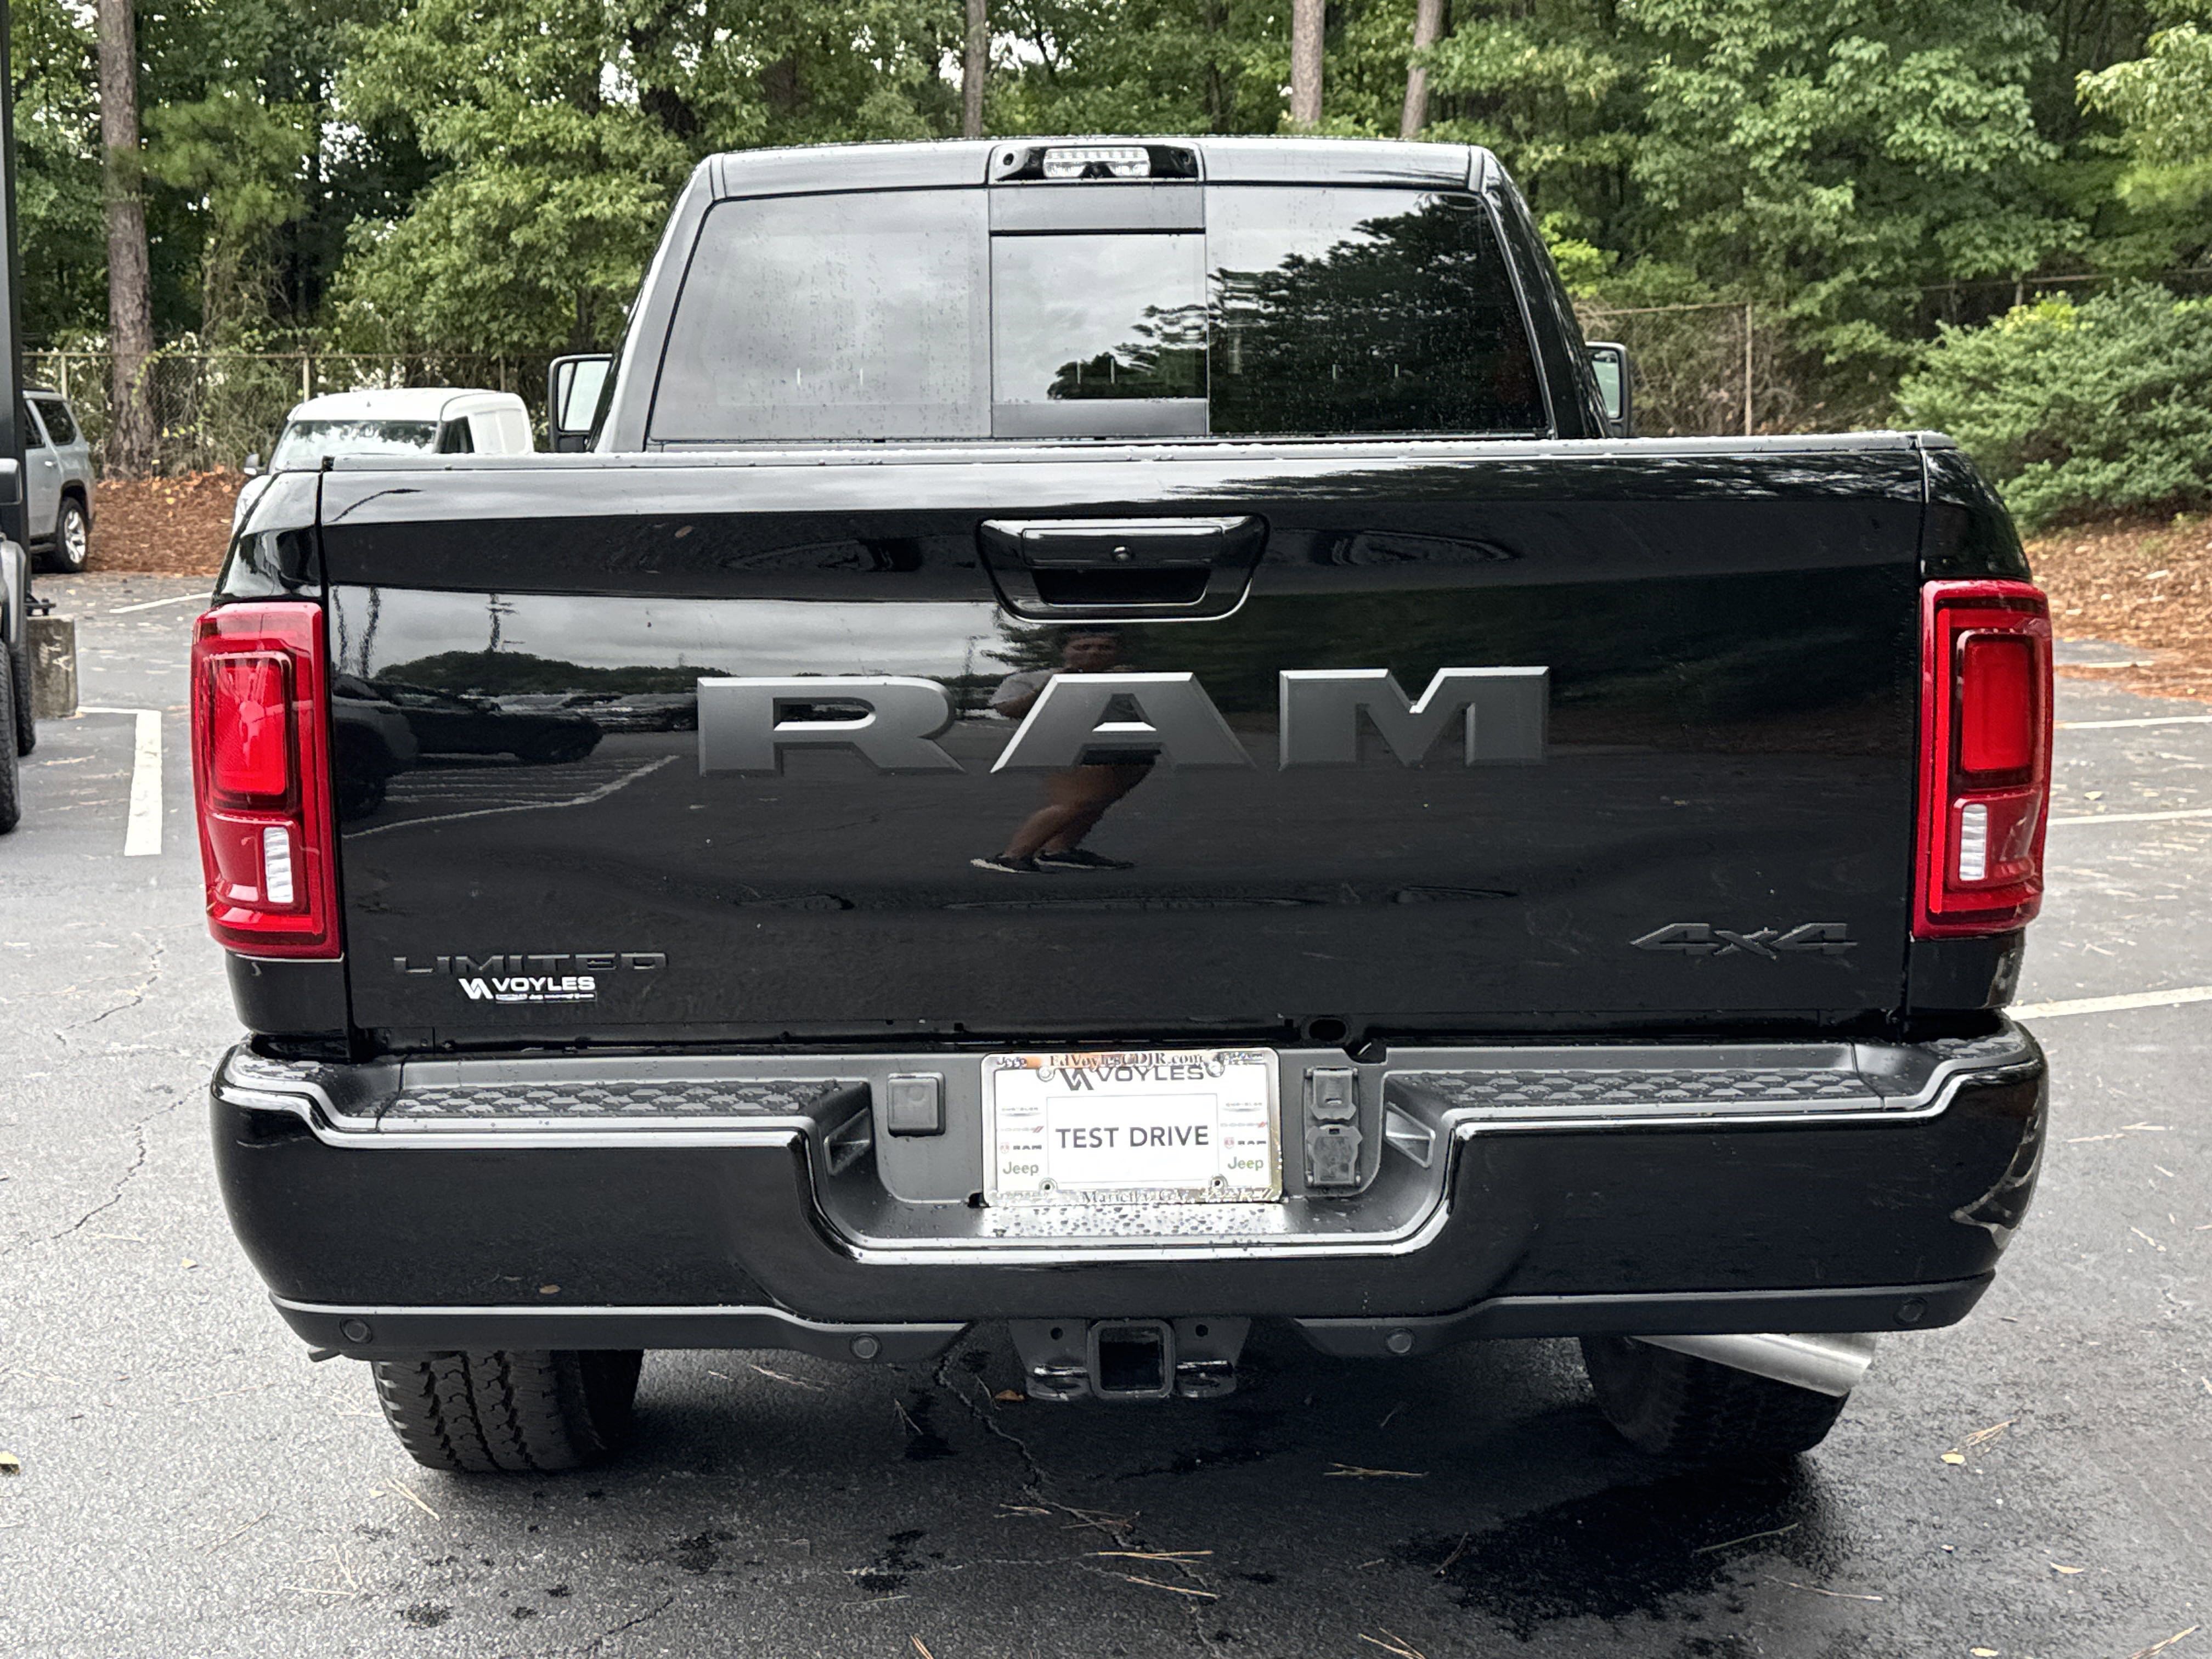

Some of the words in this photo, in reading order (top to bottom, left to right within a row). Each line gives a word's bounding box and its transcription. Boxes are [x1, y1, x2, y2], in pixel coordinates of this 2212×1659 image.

[697, 665, 1550, 775] RAM
[393, 952, 668, 973] LIMITED
[492, 977, 595, 991] VOYLES
[1097, 1065, 1204, 1082] VOYLES
[1056, 1127, 1119, 1148] TEST
[1130, 1125, 1209, 1147] DRIVE
[1002, 1161, 1040, 1176] Jeep
[1227, 1156, 1264, 1171] Jeep
